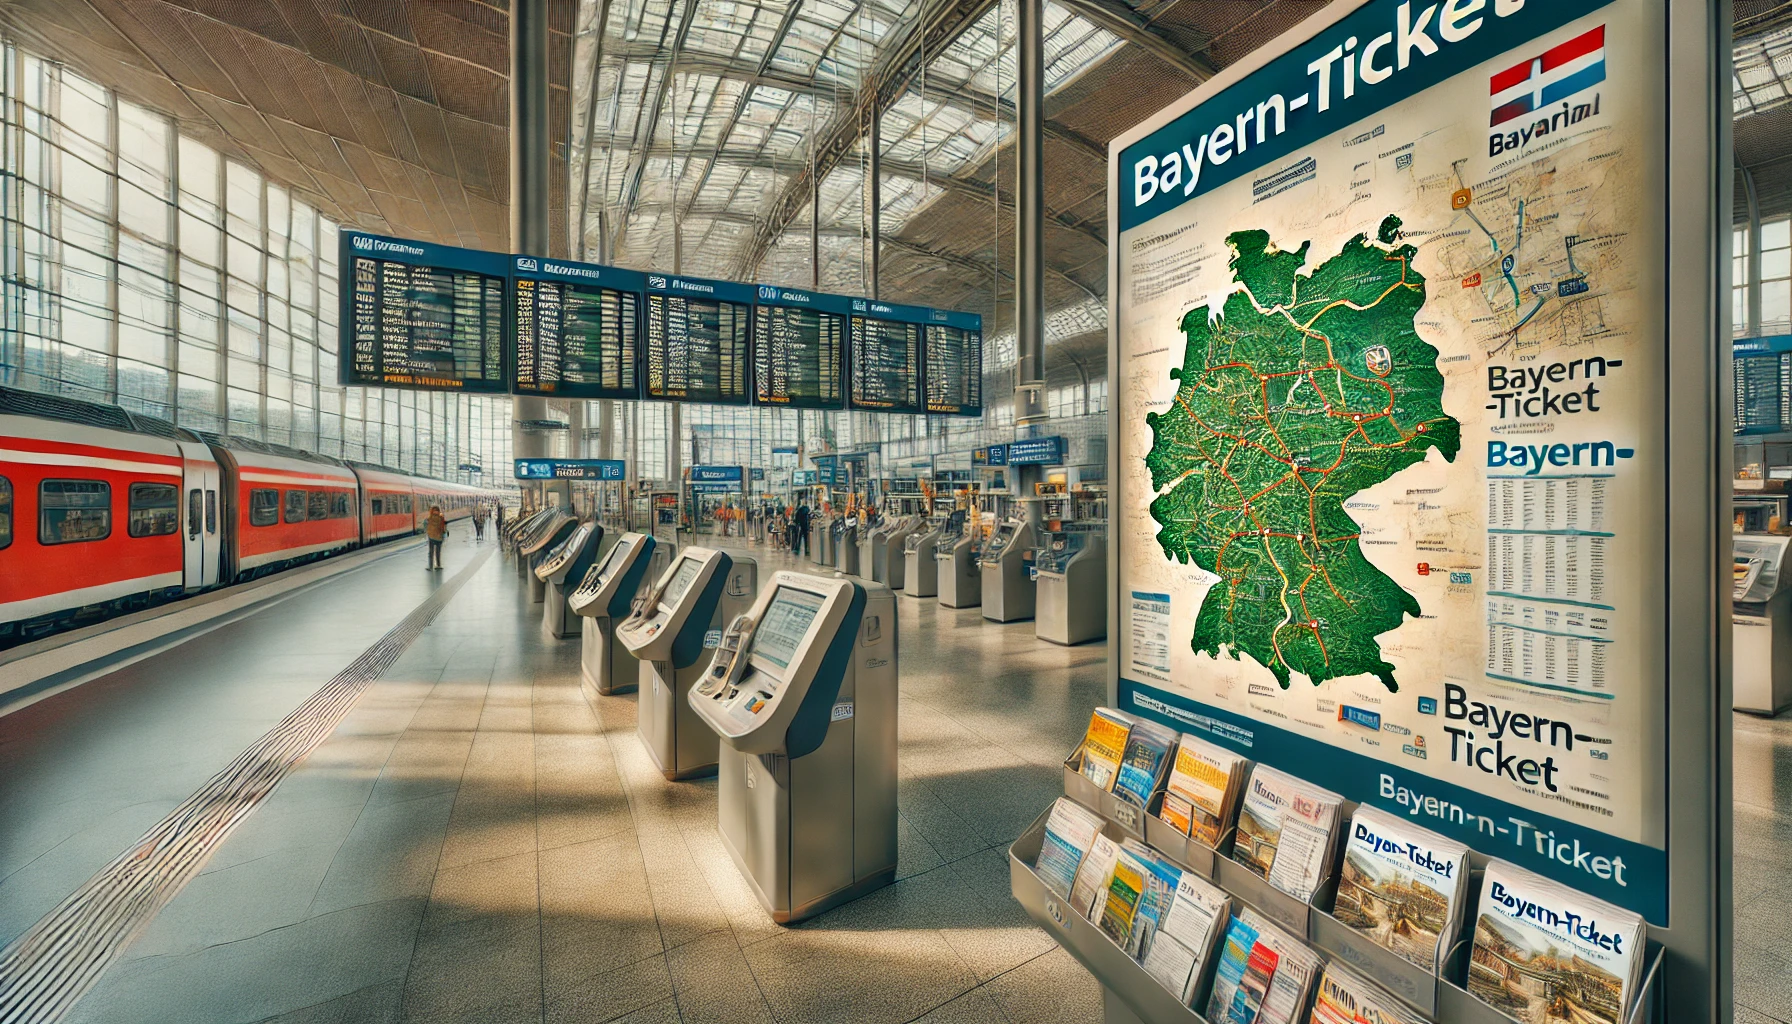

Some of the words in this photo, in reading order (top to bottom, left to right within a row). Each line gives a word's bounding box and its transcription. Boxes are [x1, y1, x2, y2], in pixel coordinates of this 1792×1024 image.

[1134, 0, 1526, 207] Bayern-Ticke
[1488, 356, 1623, 394] Bayern-
[1487, 441, 1635, 475] Bayern-
[1444, 683, 1592, 751] Bayern-
[1444, 726, 1559, 793] Ticket
